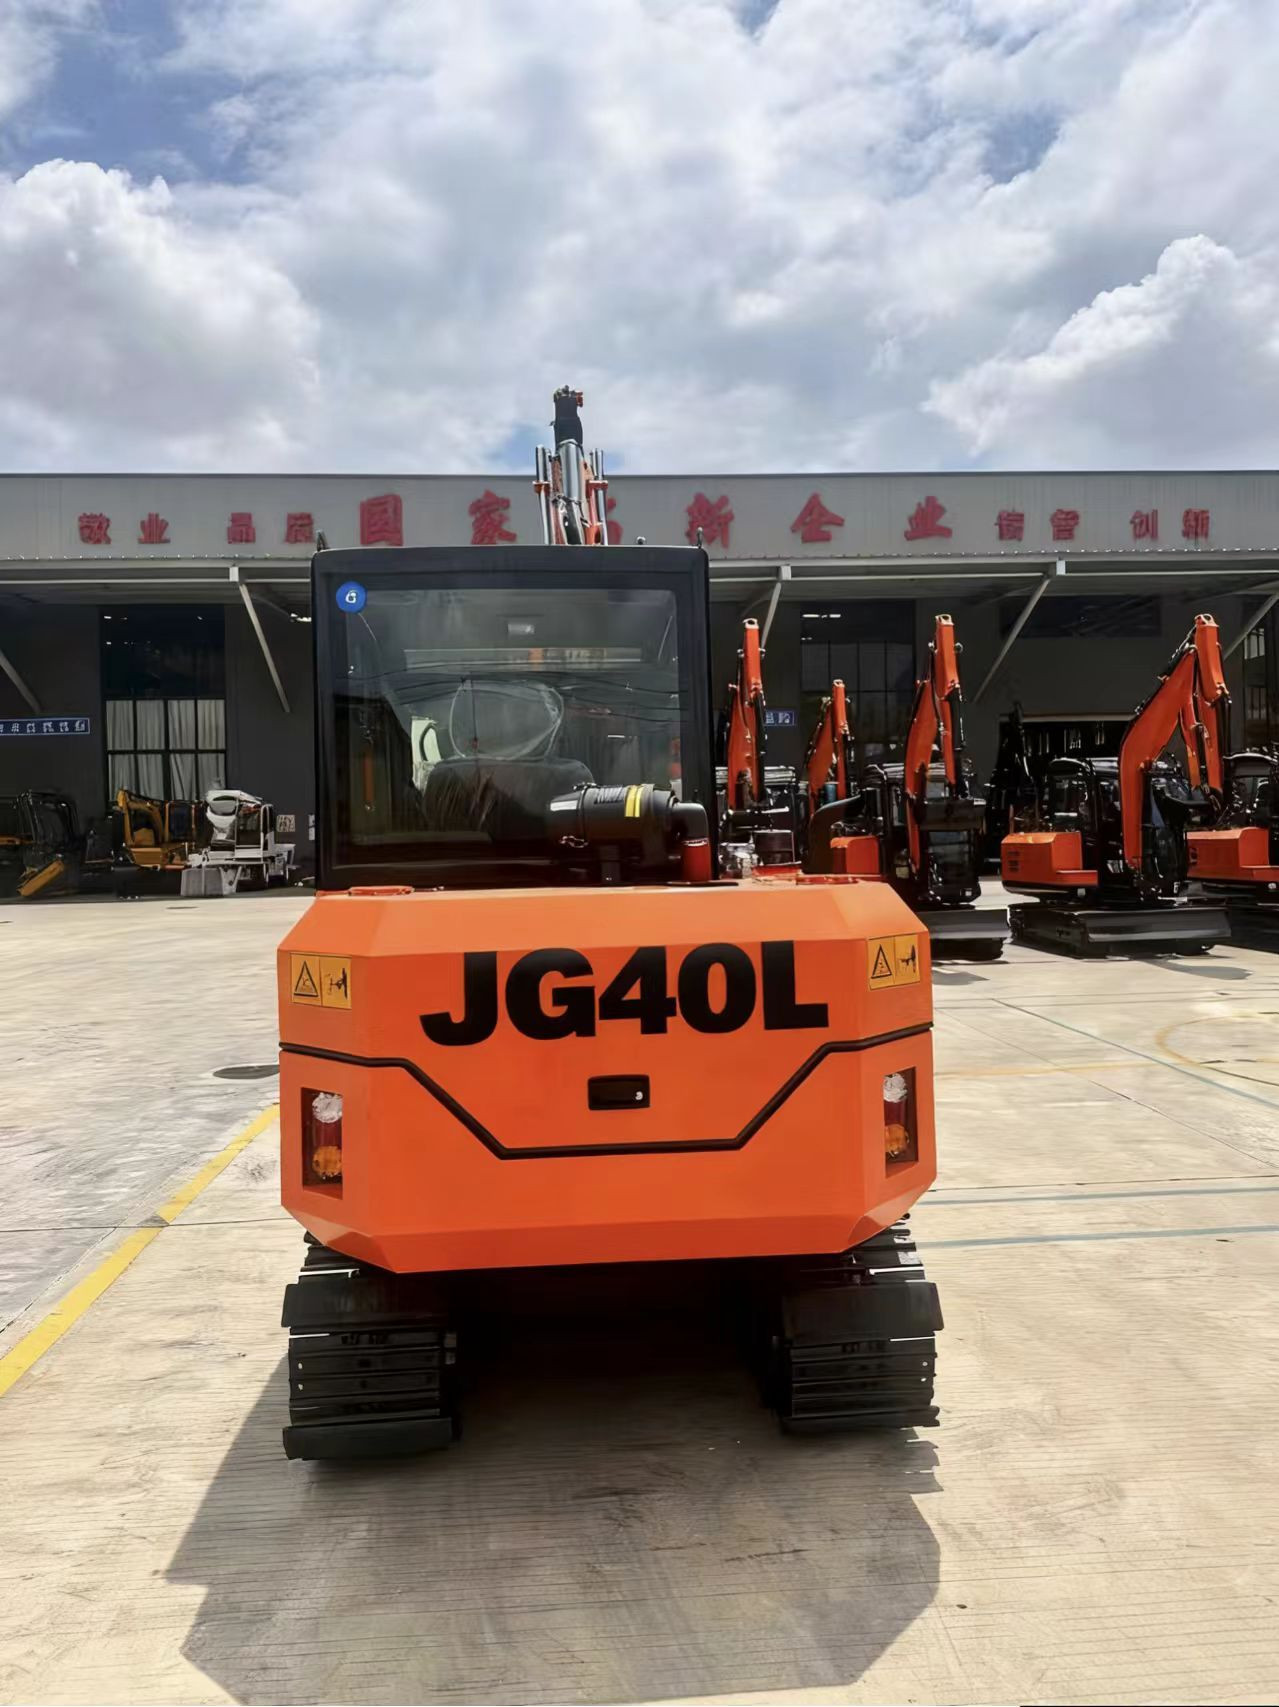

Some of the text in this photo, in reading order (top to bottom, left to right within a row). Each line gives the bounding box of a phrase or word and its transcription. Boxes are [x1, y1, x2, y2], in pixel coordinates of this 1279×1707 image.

[360, 489, 952, 548] 国家新企业
[1130, 509, 1210, 542] 创新
[419, 940, 829, 1046] JG40L
